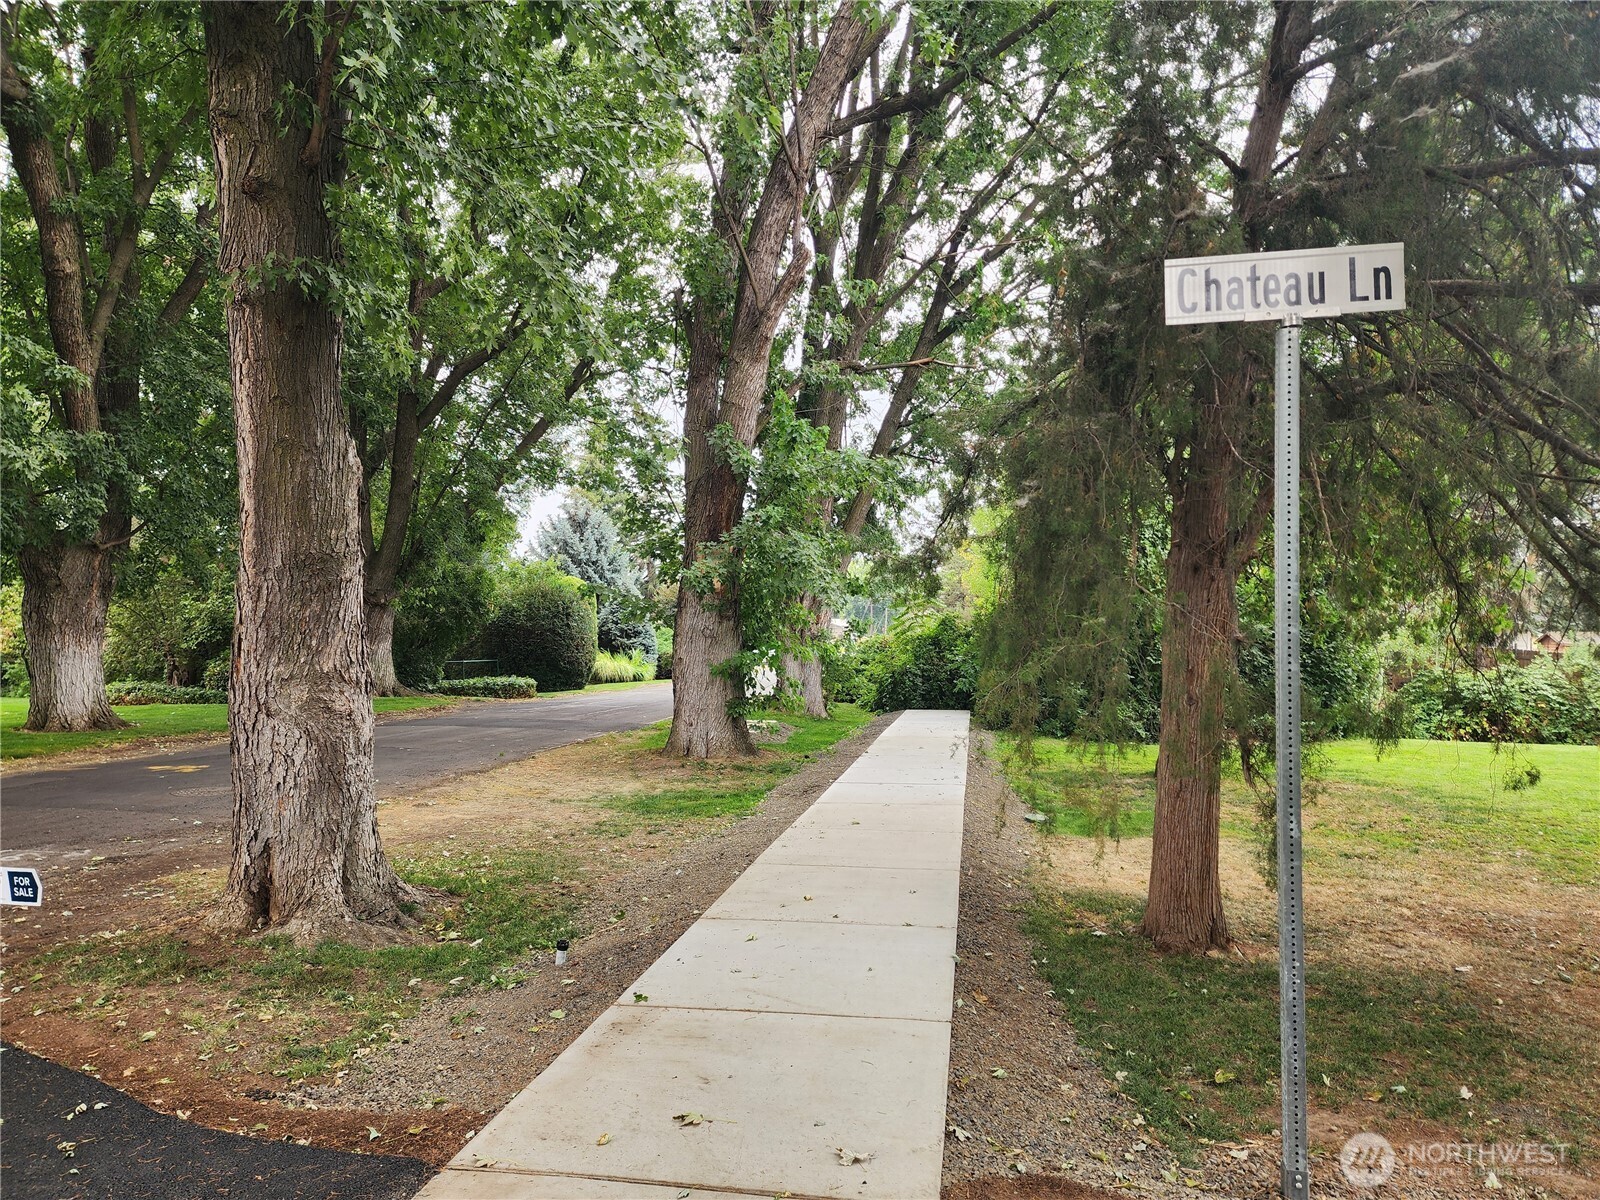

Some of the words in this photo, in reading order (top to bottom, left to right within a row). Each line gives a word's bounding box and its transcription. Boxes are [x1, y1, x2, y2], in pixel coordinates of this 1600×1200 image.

[1177, 263, 1326, 314] Chateau
[1348, 256, 1393, 303] Ln
[13, 876, 30, 886] FOR
[13, 887, 34, 897] SALE
